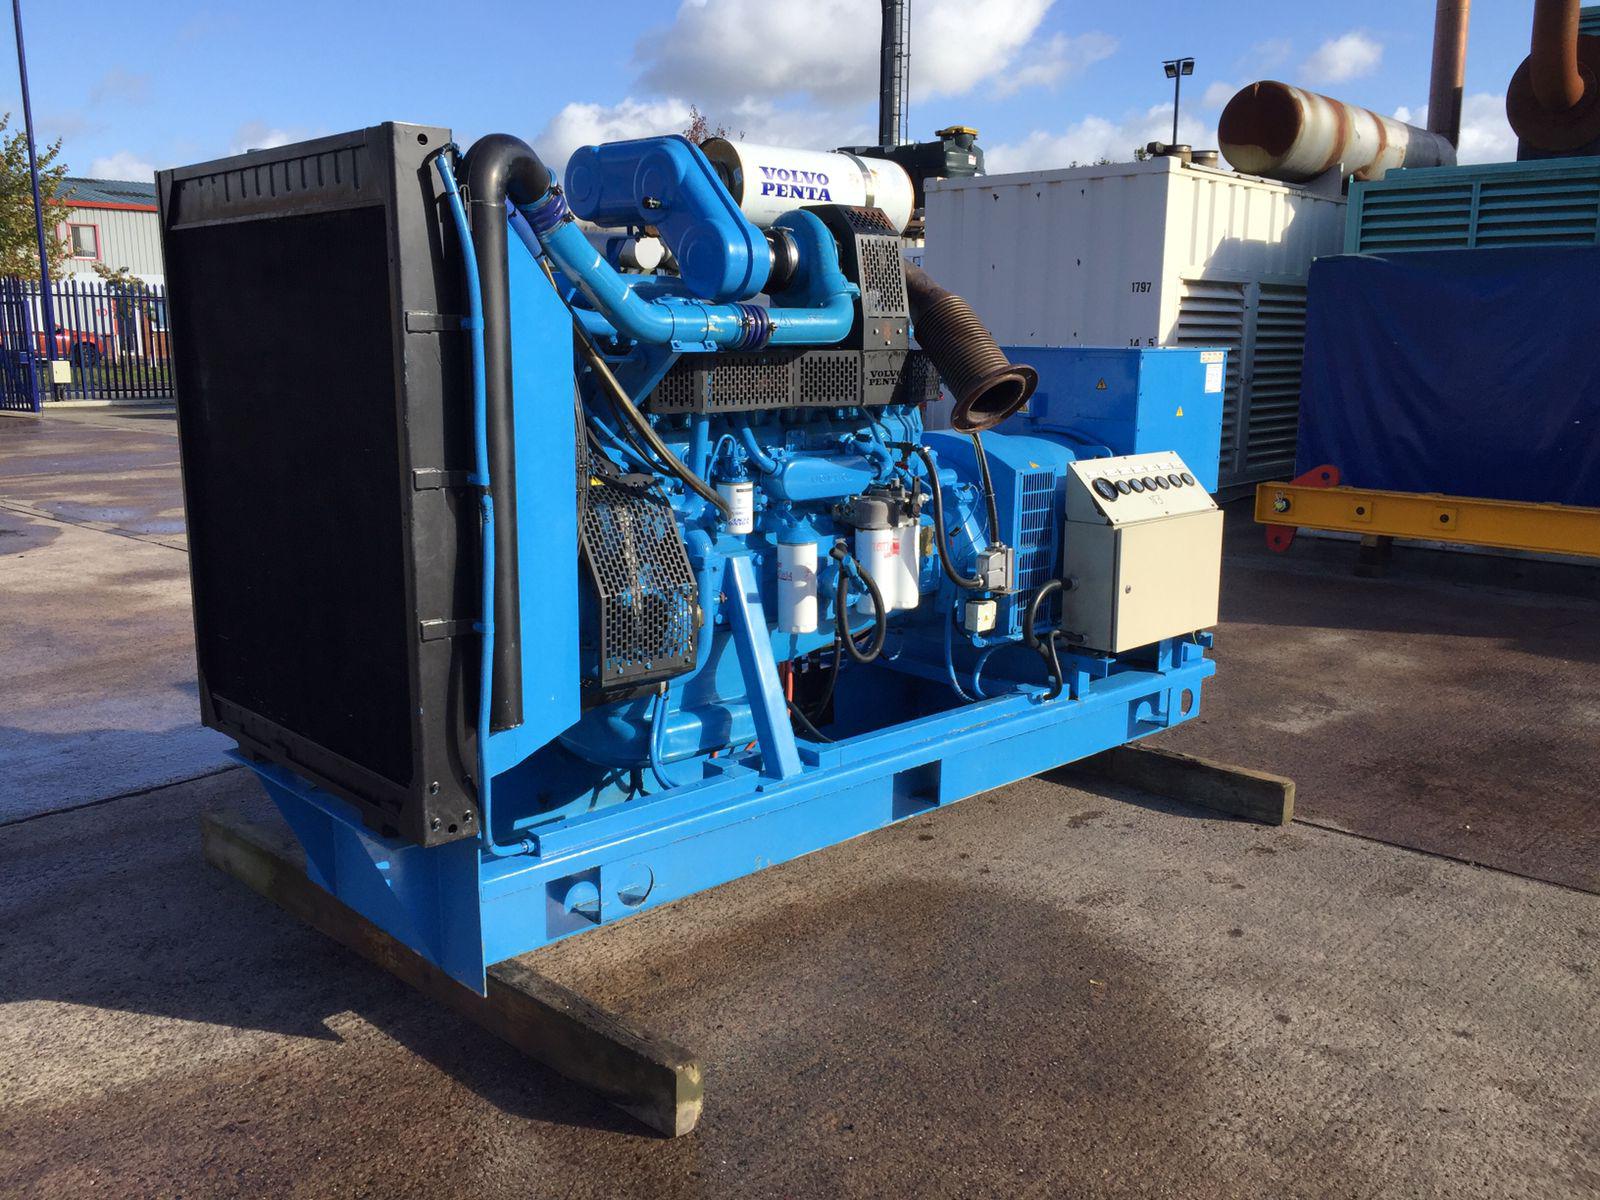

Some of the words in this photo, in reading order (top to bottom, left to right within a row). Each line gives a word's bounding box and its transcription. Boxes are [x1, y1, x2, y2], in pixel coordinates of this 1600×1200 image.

[759, 165, 829, 185] VOLVO
[760, 181, 832, 202] PENTA
[1131, 281, 1152, 293] 1797
